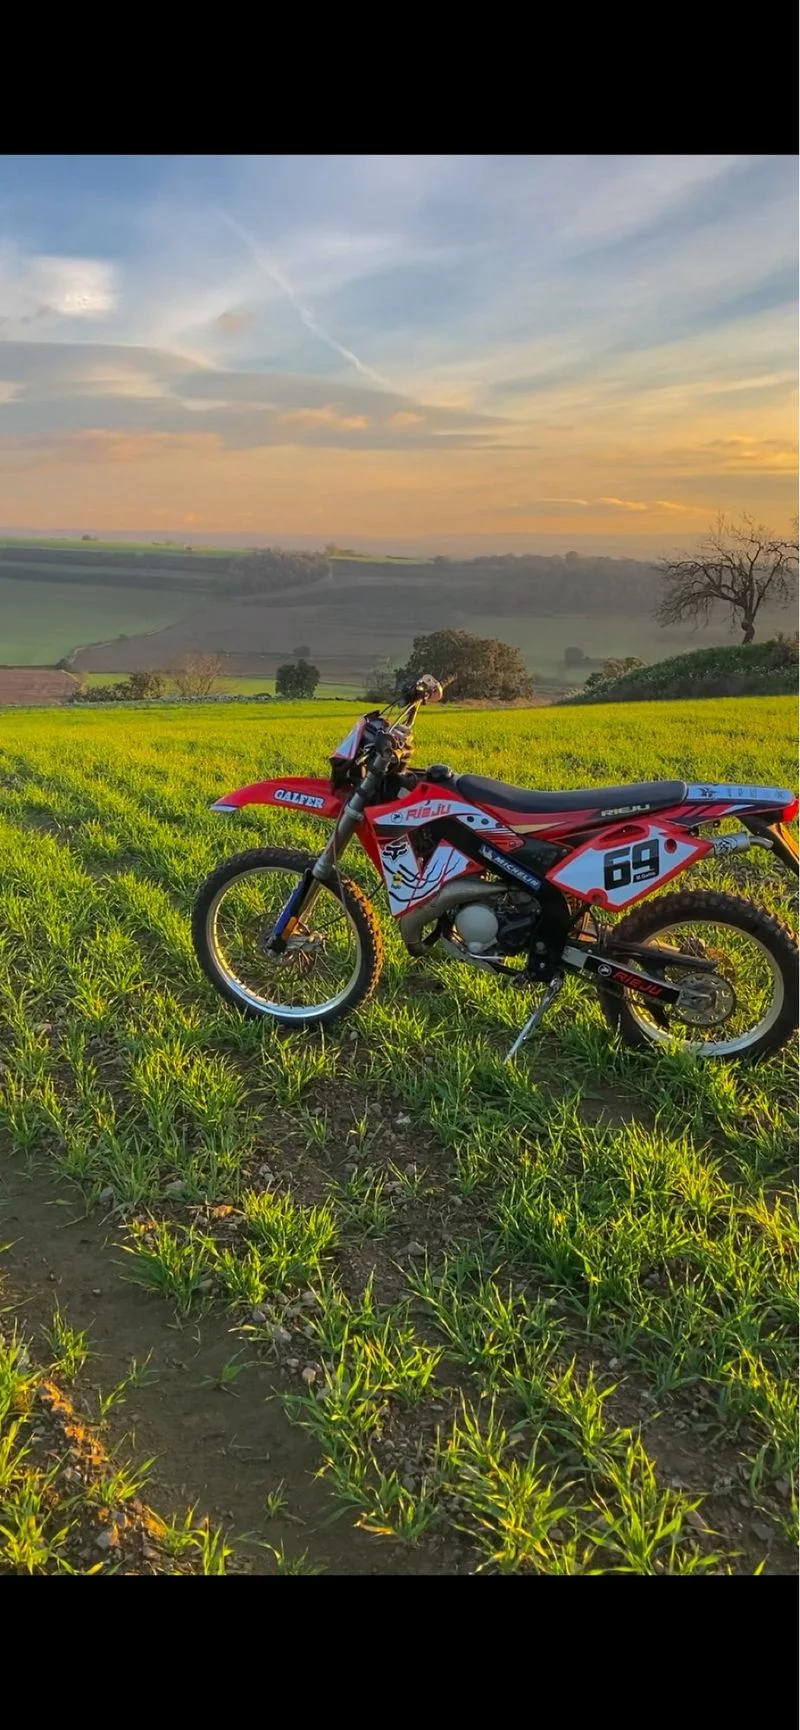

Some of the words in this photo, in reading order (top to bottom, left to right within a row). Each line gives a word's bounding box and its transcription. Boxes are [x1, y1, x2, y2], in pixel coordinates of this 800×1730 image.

[273, 788, 325, 809] GALFER
[494, 856, 540, 887] MICHELIN
[603, 838, 660, 891] 69
[612, 970, 664, 998] RIEJU
